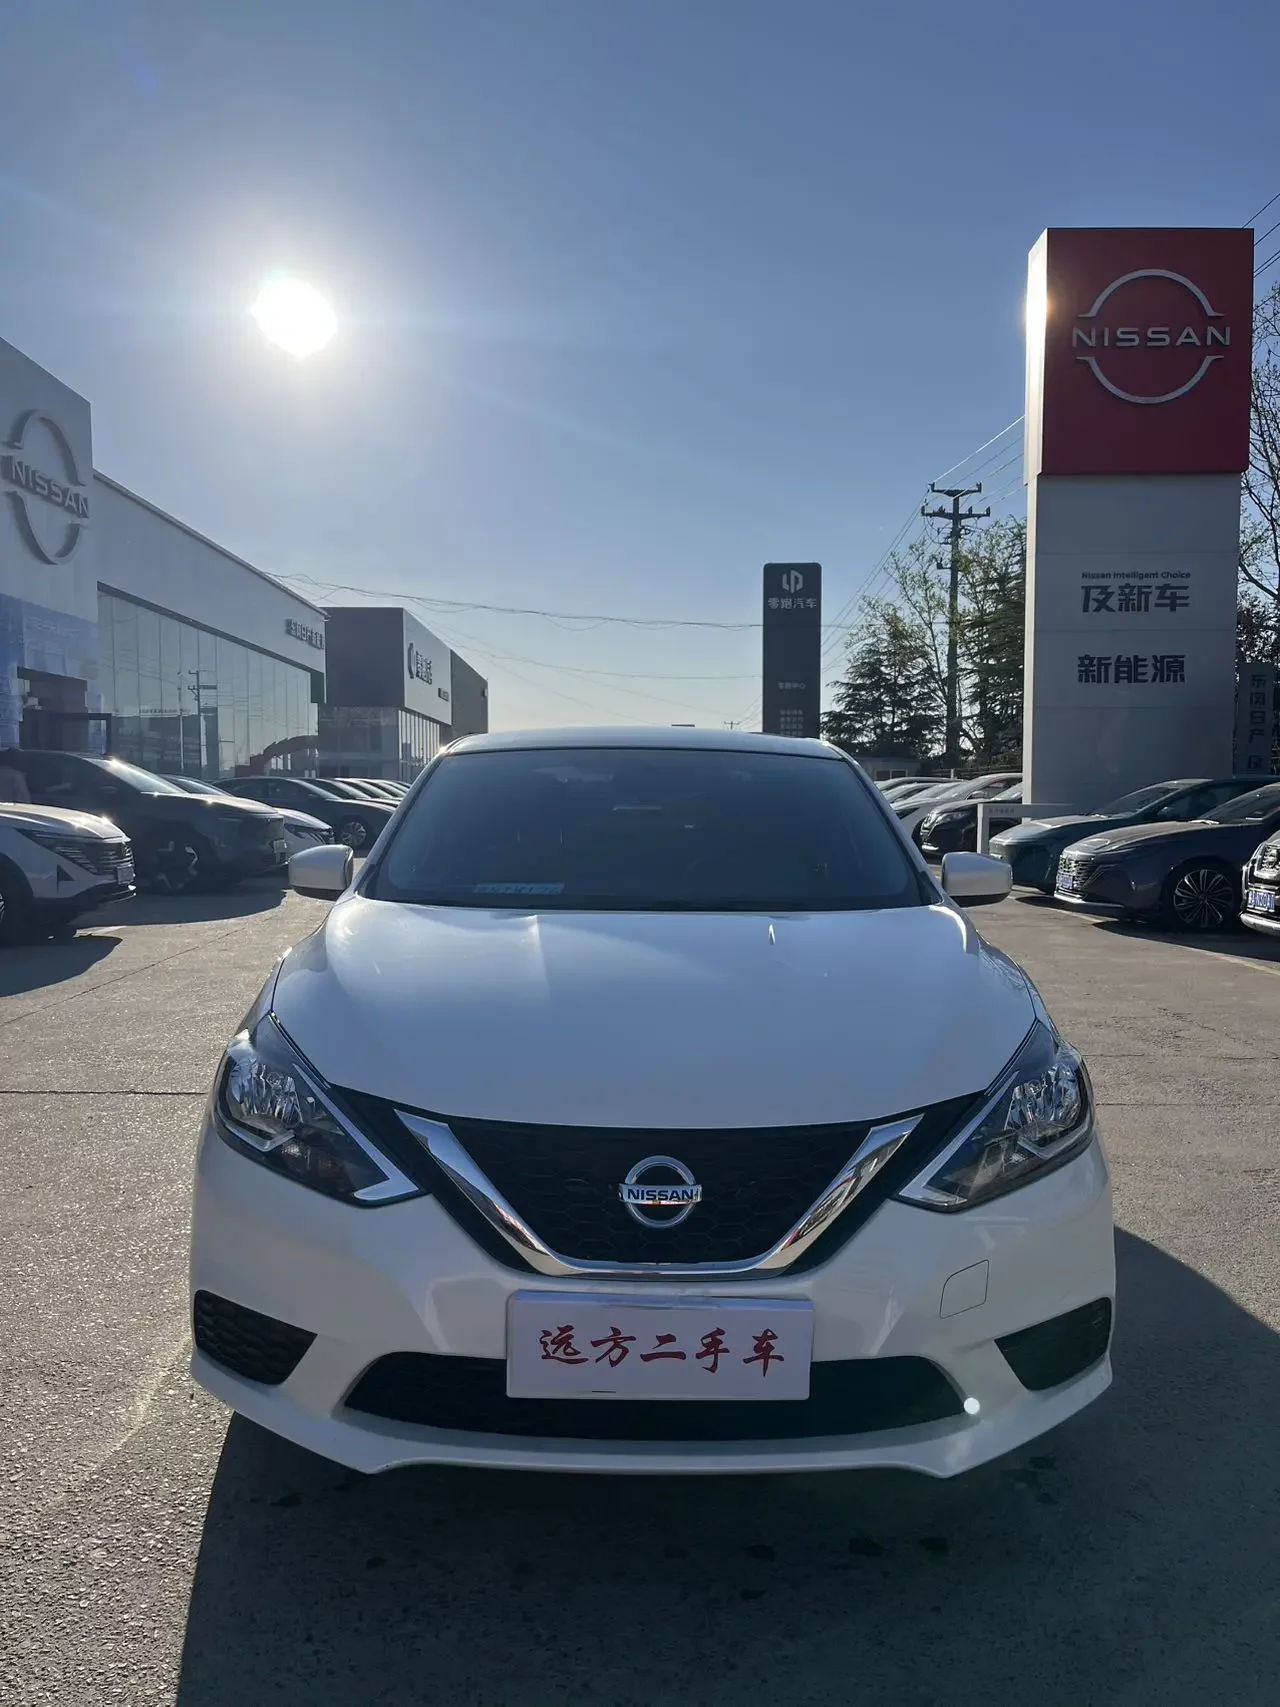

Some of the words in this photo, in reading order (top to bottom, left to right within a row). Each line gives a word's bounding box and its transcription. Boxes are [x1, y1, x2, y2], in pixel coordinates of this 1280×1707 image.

[1072, 326, 1231, 347] NISSAN
[11, 457, 89, 518] NISSAN
[1082, 571, 1111, 579] Nissan
[1113, 571, 1158, 580] Intelligent
[1161, 571, 1190, 579] Choice
[1078, 654, 1186, 684] 新能源
[1249, 674, 1267, 744] 东风日产
[627, 1188, 694, 1201] NISSAN
[538, 1324, 784, 1377] 远方二手车
